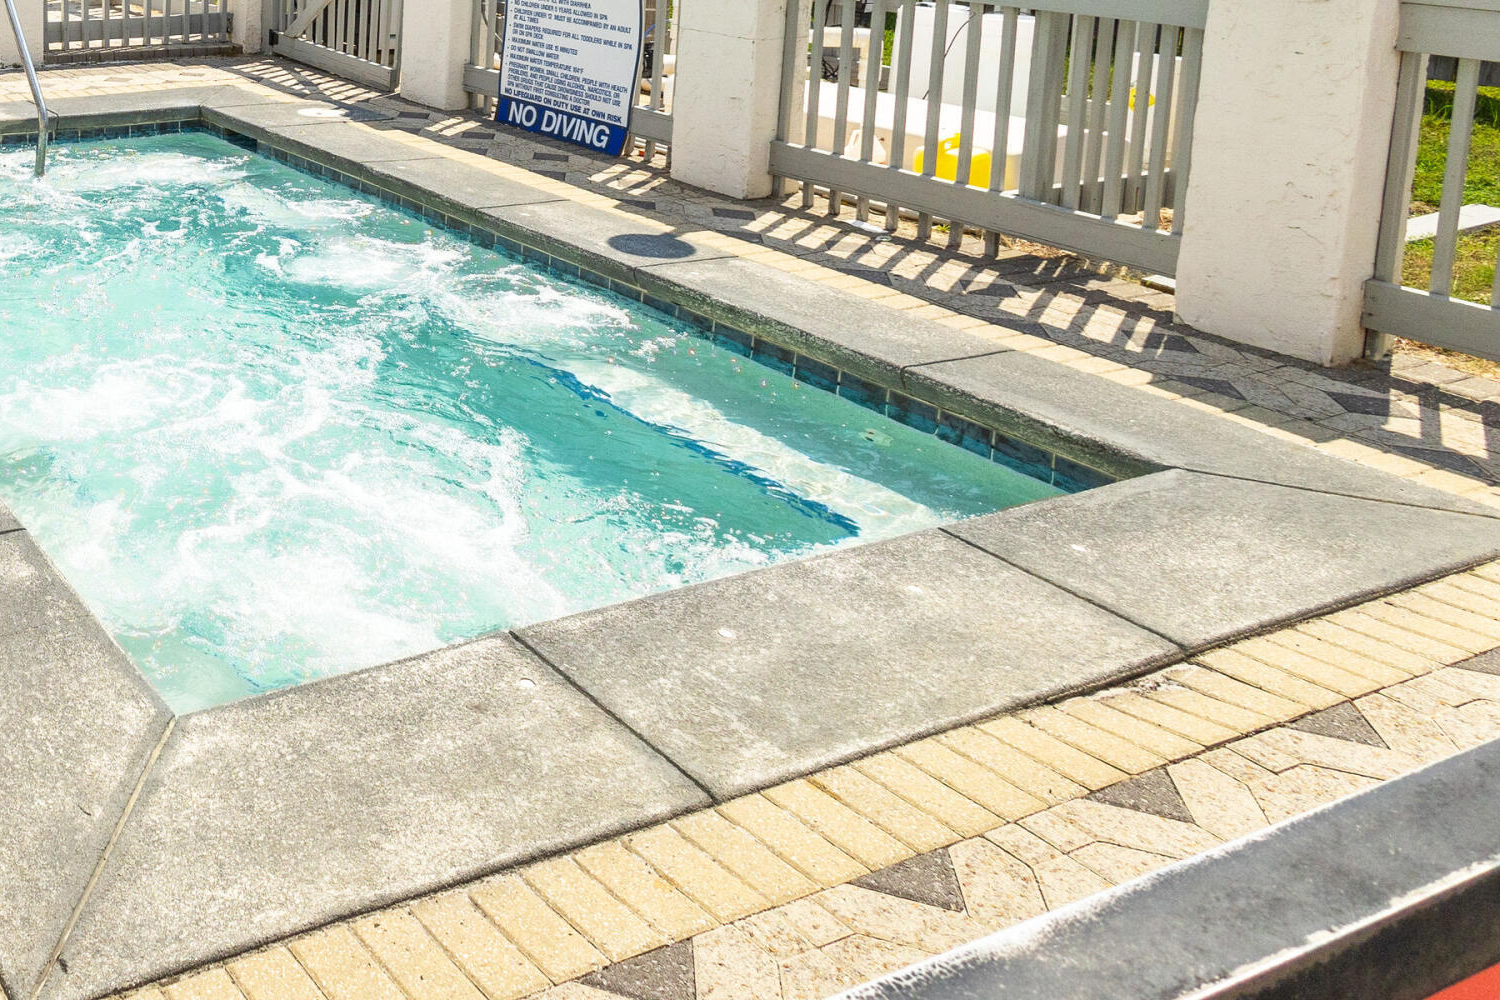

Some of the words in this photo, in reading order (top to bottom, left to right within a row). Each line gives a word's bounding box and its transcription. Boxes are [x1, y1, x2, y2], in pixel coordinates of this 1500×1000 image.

[521, 0, 539, 8] CHILDREN
[573, 9, 592, 18] ALLOWED
[570, 0, 591, 9] DIARRHEA
[514, 7, 532, 15] CHILDREN
[533, 10, 547, 18] UNDER
[554, 14, 566, 22] MUST
[573, 18, 602, 29] ACCOMPANIED
[603, 22, 609, 30] BY
[617, 26, 631, 34] ADULT
[527, 16, 539, 24] TIMES
[525, 24, 541, 33] DIAPERS
[542, 27, 562, 37] REQUIRED
[580, 35, 602, 45] TODDLERS
[603, 39, 617, 47] WHILE
[512, 36, 531, 45] MAXIMUM
[560, 46, 578, 56] MINUTES
[526, 48, 545, 57] SWALLOW
[546, 52, 559, 60] WATER
[510, 53, 529, 61] MAXIMUM
[530, 57, 543, 65] WATER
[544, 60, 572, 71] TEMPERATURE
[509, 61, 529, 70] PREGNANT
[546, 69, 559, 77] SMALL
[582, 77, 598, 86] PEOPLE
[598, 81, 610, 89] WITH
[610, 84, 628, 93] HEALTH
[539, 74, 553, 83] PEOPLE
[554, 78, 566, 87] USING
[505, 87, 512, 96] NO
[513, 89, 542, 102] LIFEGUARD
[544, 97, 552, 105] ON
[553, 99, 569, 109] DUTY
[570, 103, 581, 113] USE
[583, 107, 591, 116] AT
[591, 109, 606, 120] OWN
[607, 113, 622, 124] RISK
[533, 86, 544, 94] FIRST
[545, 90, 569, 100] CONSULTING
[573, 96, 590, 106] DOCTOR
[557, 86, 583, 97] DROWSINESS
[584, 92, 602, 102] SHOULD
[612, 99, 621, 107] USE
[508, 101, 537, 127] NO
[540, 110, 610, 149] DIVING
